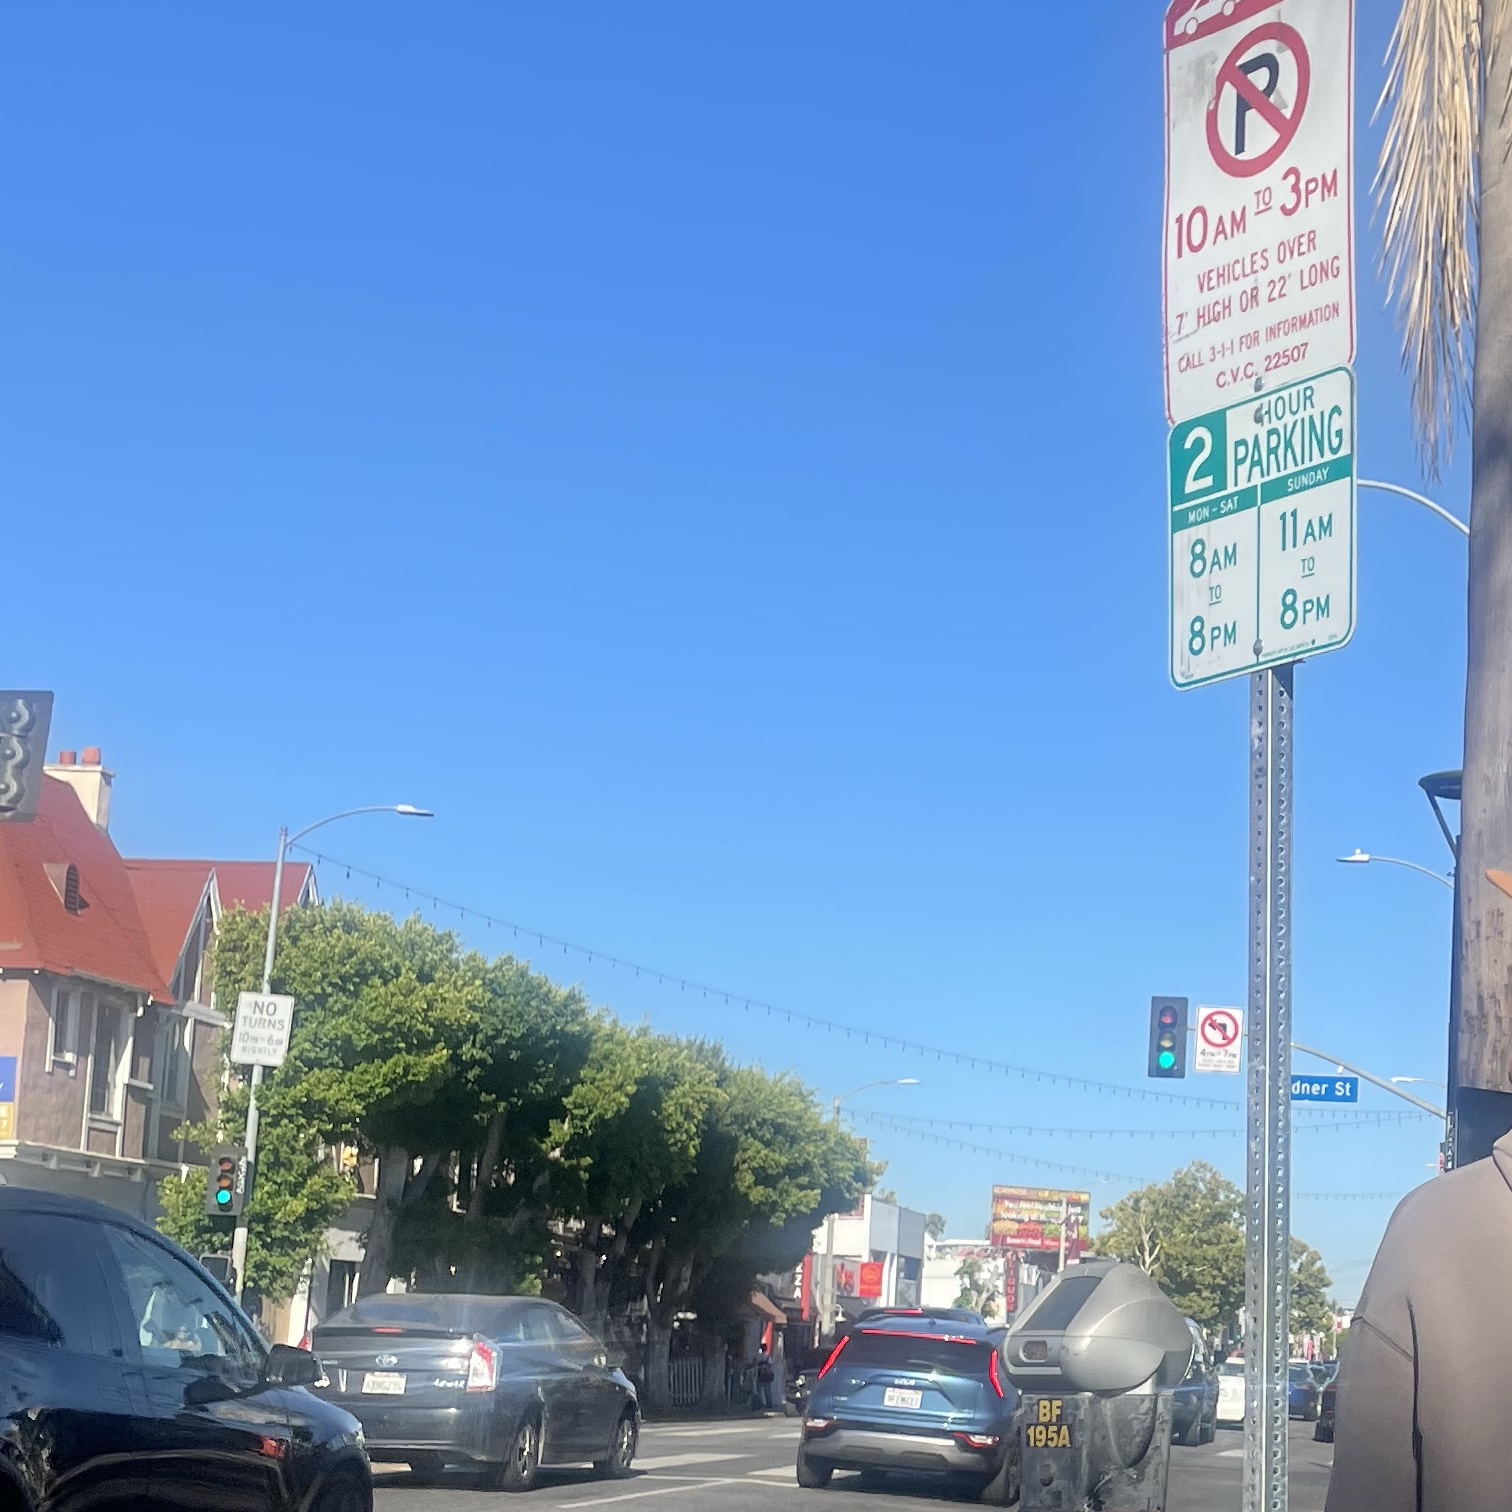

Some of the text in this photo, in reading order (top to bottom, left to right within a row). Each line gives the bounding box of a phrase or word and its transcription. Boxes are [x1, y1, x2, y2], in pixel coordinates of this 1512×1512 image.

[1197, 229, 1317, 294] VEHICLES OVER
[1196, 293, 1233, 327] HIGH
[1239, 287, 1260, 314] OR
[1299, 255, 1341, 287] LONG
[1178, 348, 1204, 374] CALL
[1239, 329, 1261, 353] FOR
[1264, 300, 1340, 343] INFORMATION
[1215, 342, 1309, 389] C.V.C. 22507
[1259, 385, 1316, 426] HOUR
[1183, 404, 1344, 495] 2 PARKING
[1287, 467, 1330, 492] SUNDAY
[1301, 555, 1315, 576] TO
[1208, 584, 1222, 604] TO
[253, 1000, 277, 1016] NO
[242, 1016, 285, 1031] TURNS
[1291, 1079, 1351, 1097] dner St
[1038, 1400, 1063, 1423] BF
[1027, 1424, 1072, 1448] 195A
